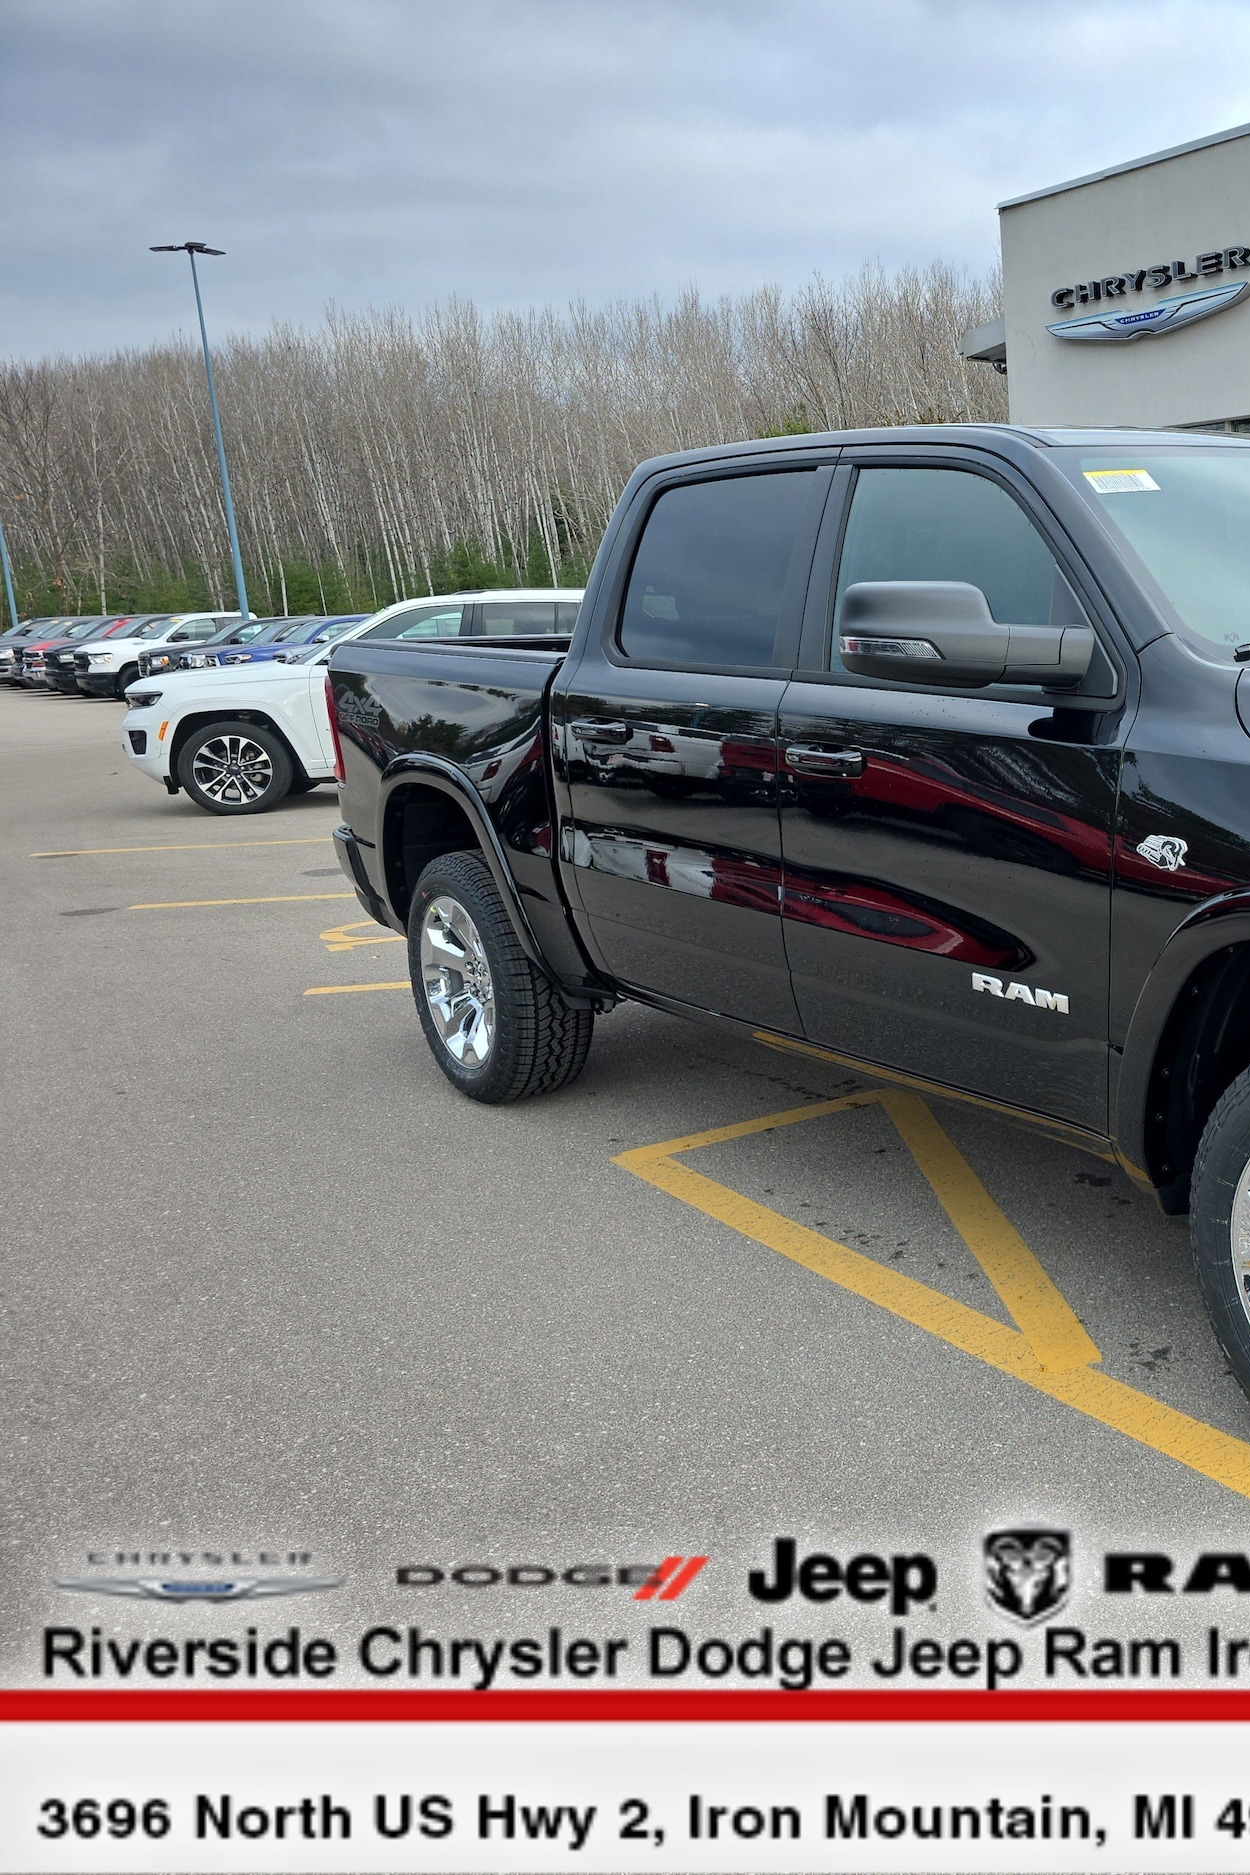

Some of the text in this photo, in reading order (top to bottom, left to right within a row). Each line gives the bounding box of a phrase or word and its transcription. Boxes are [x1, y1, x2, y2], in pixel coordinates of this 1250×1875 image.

[1119, 311, 1160, 324] CHRYSLER
[355, 714, 380, 726] ROAD
[971, 972, 1070, 1015] RAM
